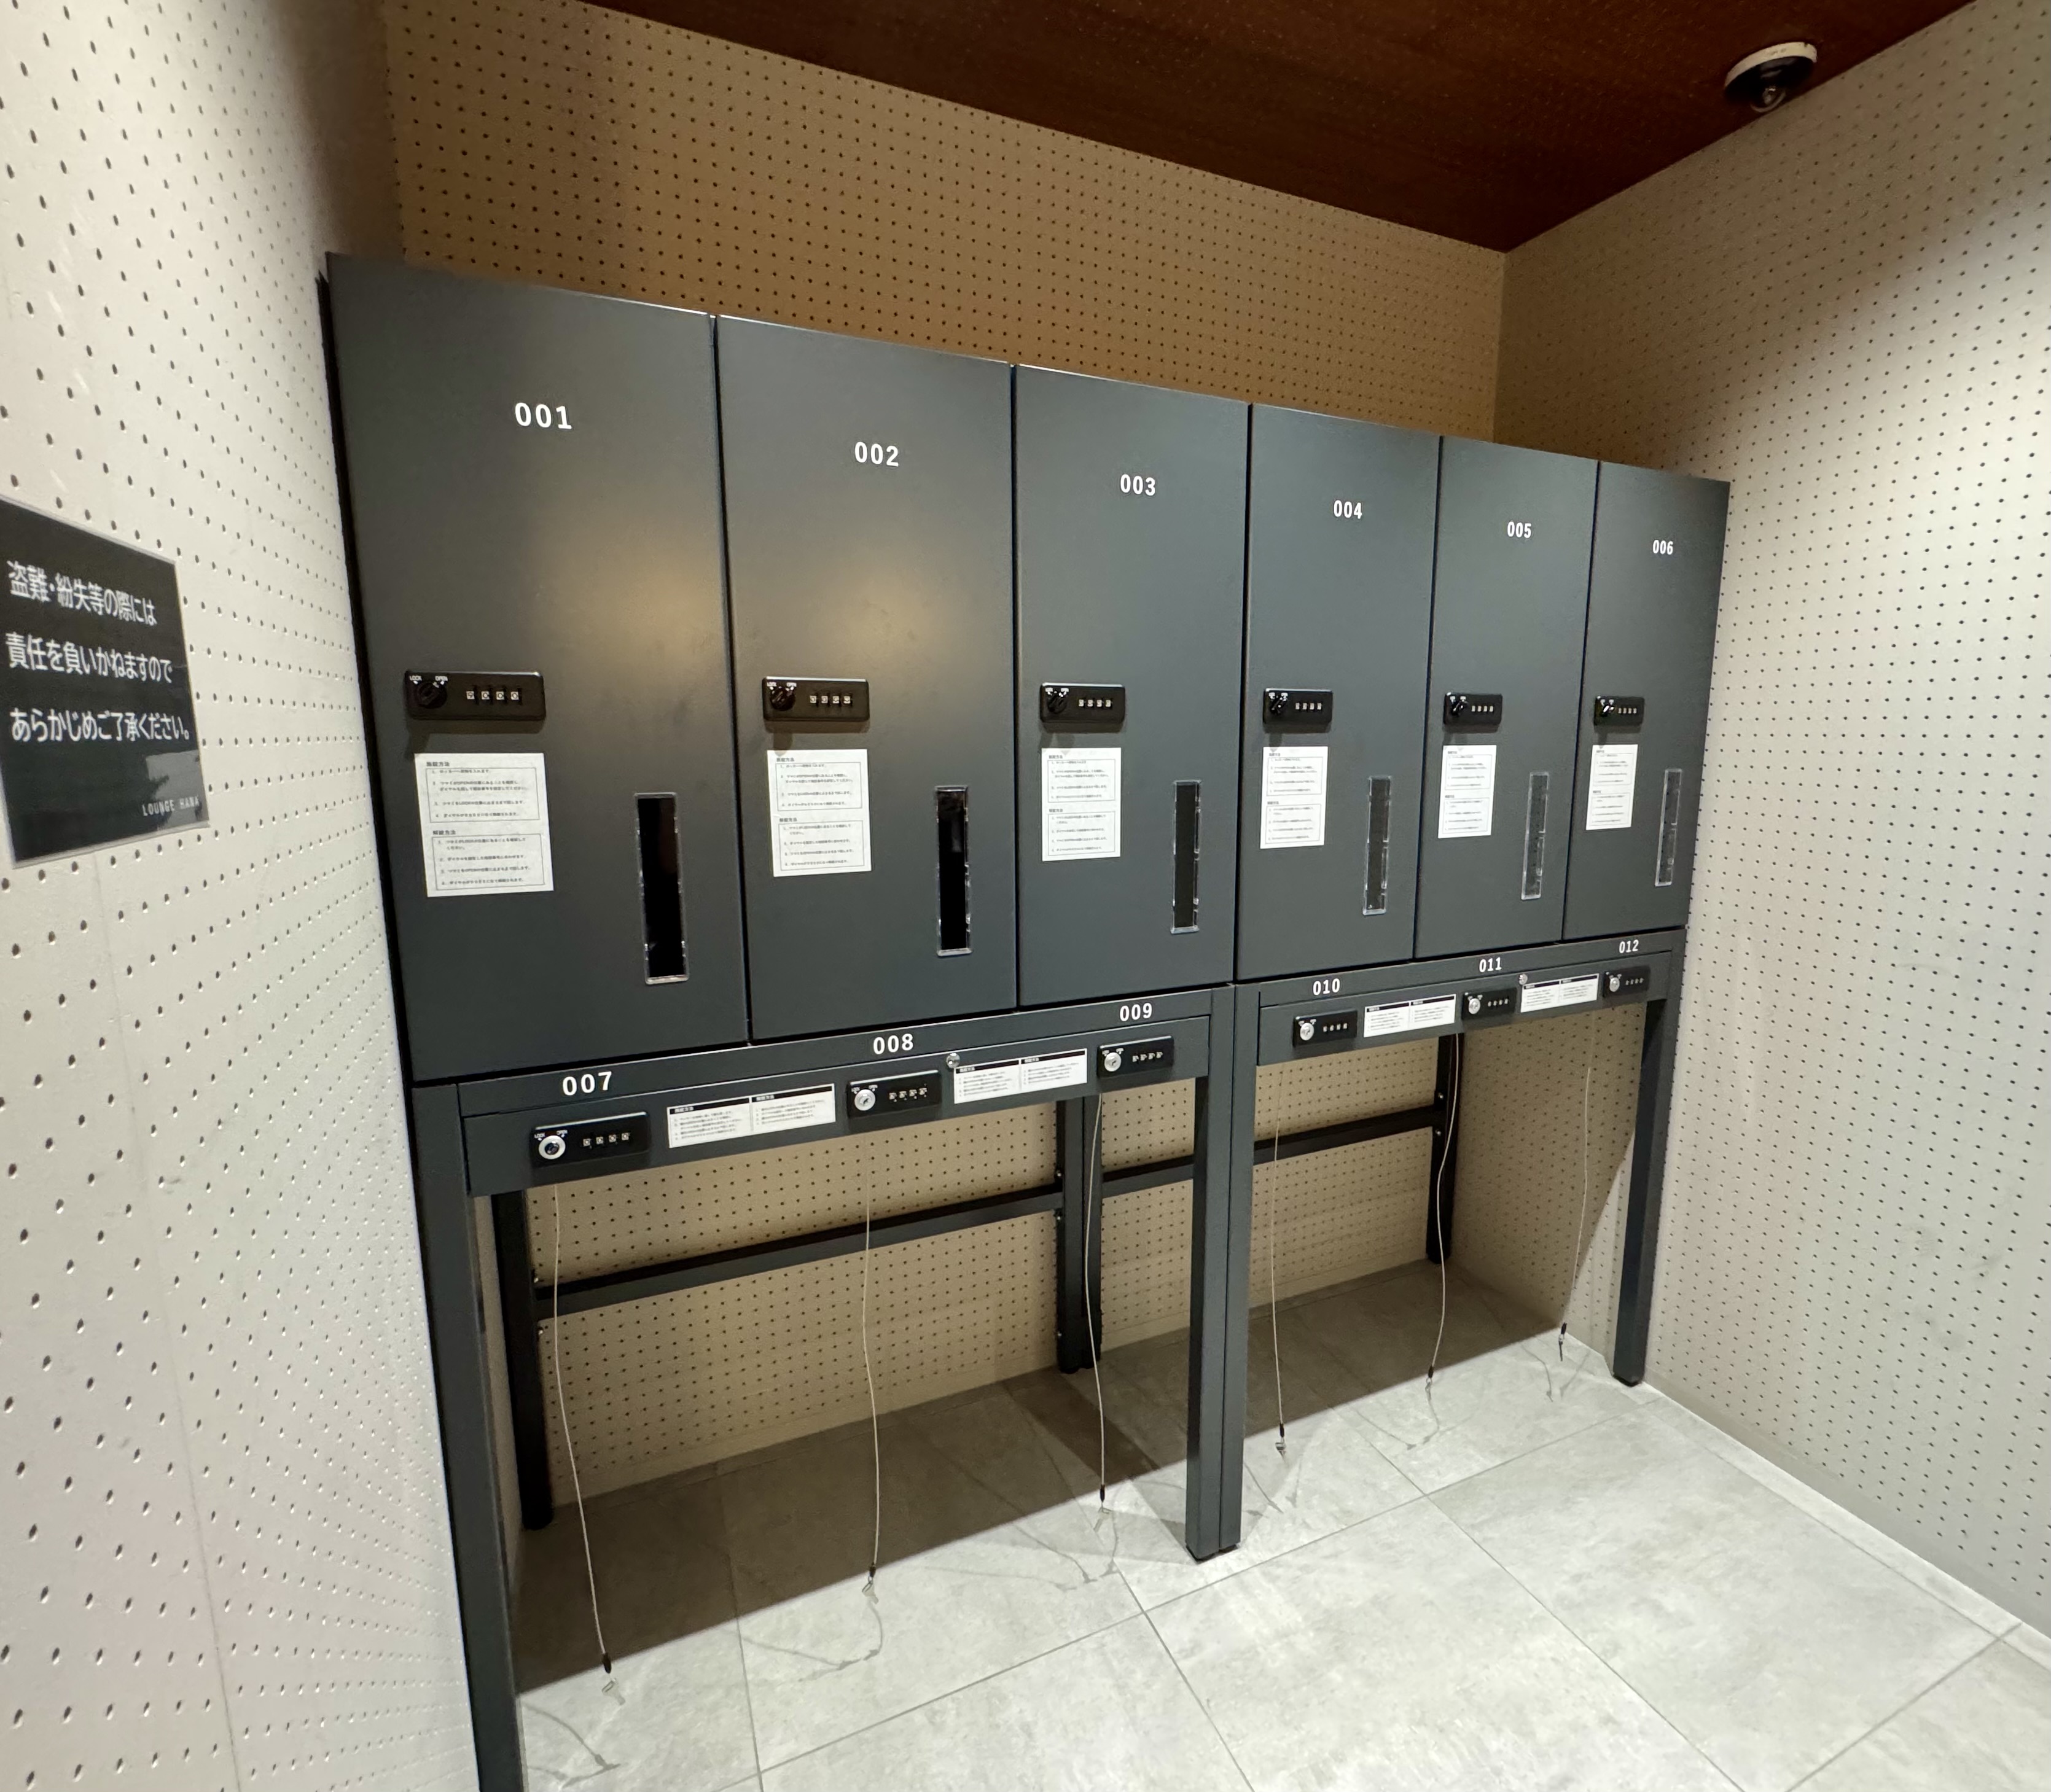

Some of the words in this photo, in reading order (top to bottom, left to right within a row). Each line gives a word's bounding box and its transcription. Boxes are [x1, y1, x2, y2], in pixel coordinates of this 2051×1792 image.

[515, 402, 572, 430] 001
[854, 441, 900, 467] 002
[1120, 473, 1155, 496] 003
[1333, 500, 1362, 520] 004
[1506, 521, 1532, 539] 005
[1652, 539, 1674, 555] 006
[7, 560, 157, 625] 盗難・紛失等の際には
[5, 631, 173, 684] 責任を負いかねますので
[9, 707, 190, 742] あらかじめご了承ください。
[142, 800, 175, 817] LOUNGE
[1619, 939, 1639, 953] 012
[1479, 957, 1502, 973] 011
[1313, 978, 1340, 995] 010
[1119, 1003, 1153, 1022] 009
[872, 1034, 914, 1055] 008
[562, 1071, 612, 1096] 007
